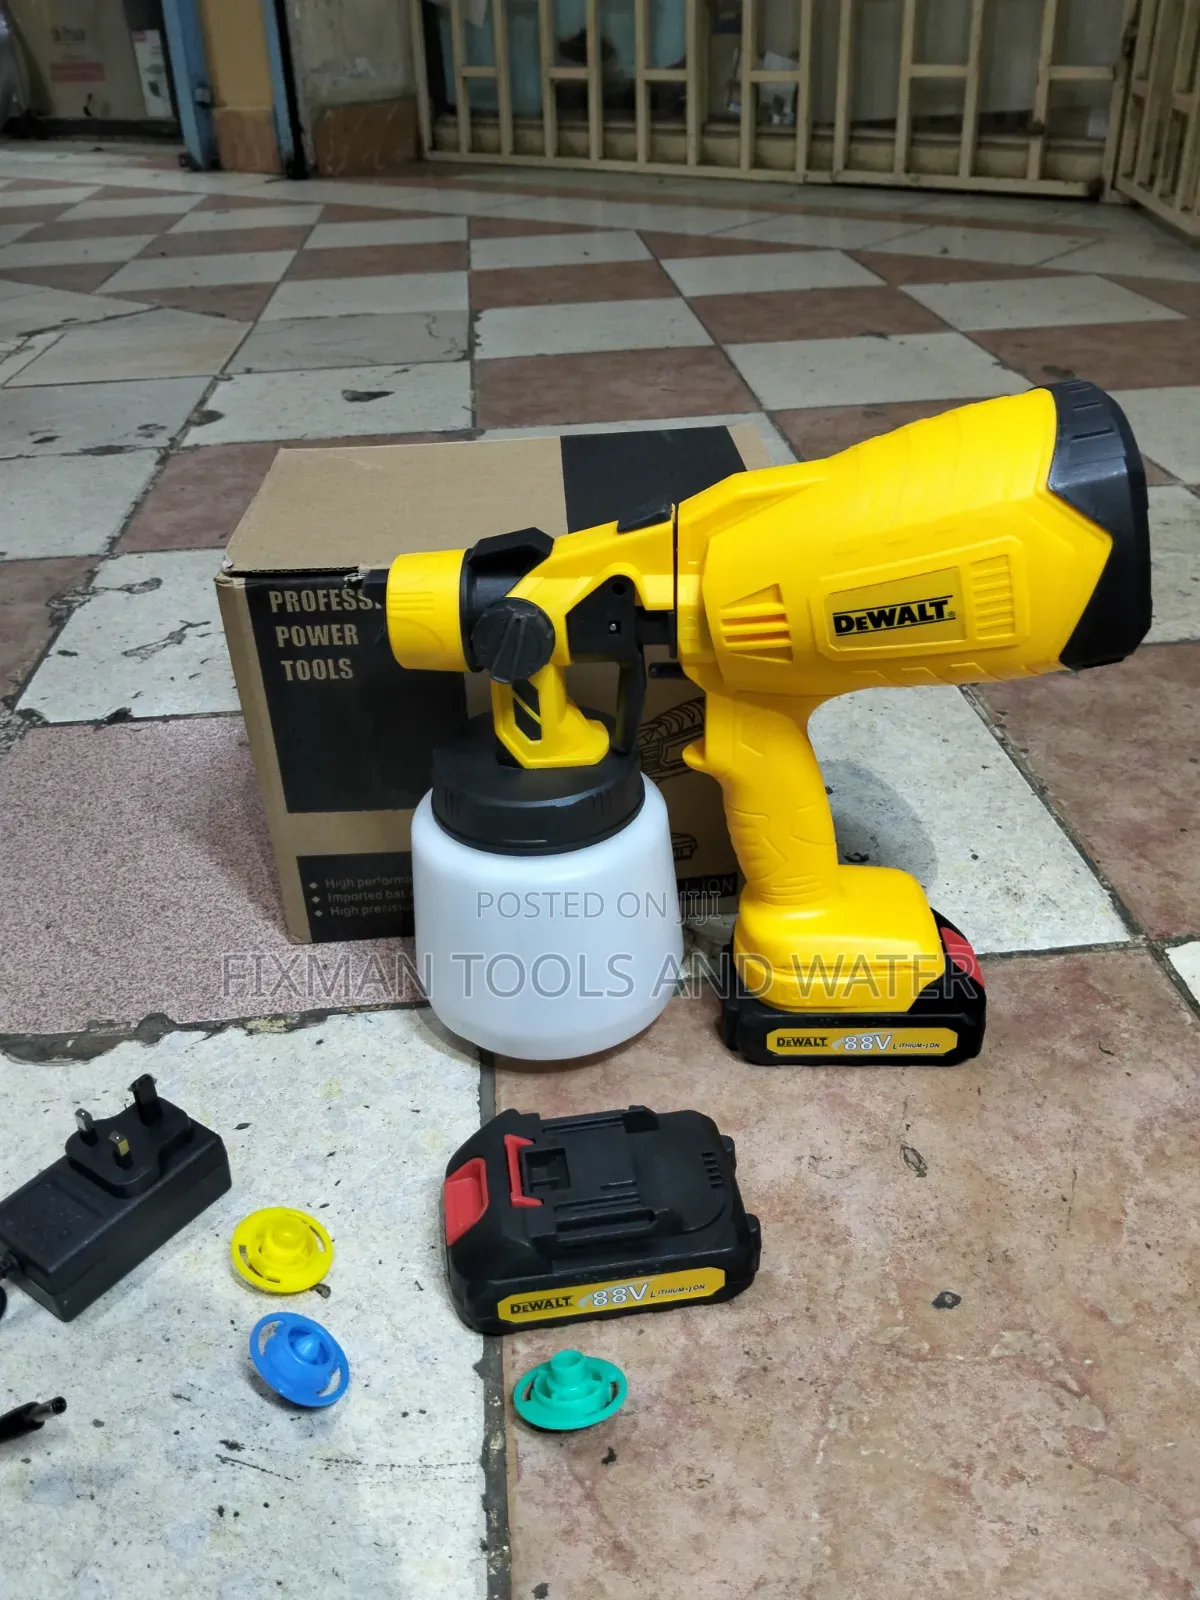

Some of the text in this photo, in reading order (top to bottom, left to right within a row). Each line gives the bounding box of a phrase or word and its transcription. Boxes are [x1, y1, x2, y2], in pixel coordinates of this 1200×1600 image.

[268, 588, 382, 613] PROFESS
[275, 623, 359, 648] POWER
[280, 658, 354, 681] TOOLS
[325, 879, 354, 890] High
[327, 890, 382, 904] Imported
[329, 906, 359, 917] High
[844, 1035, 893, 1051] 88V
[591, 1283, 649, 1308] 88V
